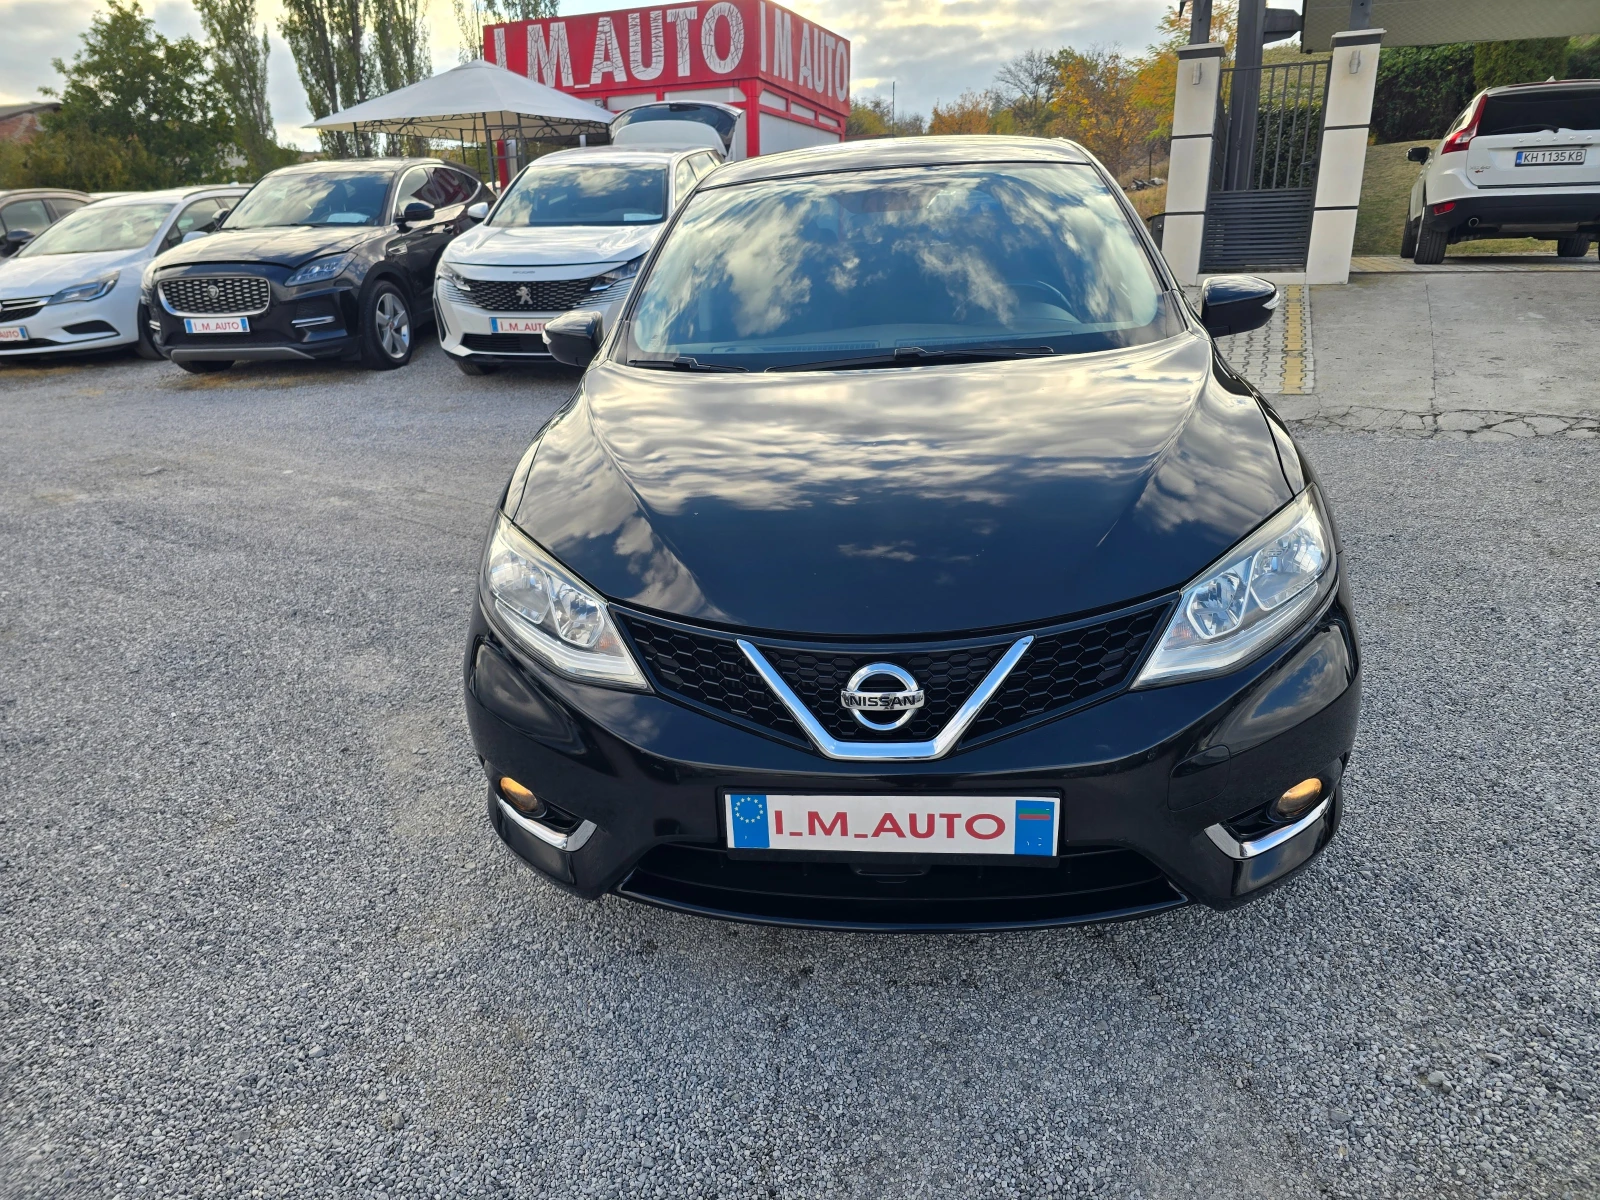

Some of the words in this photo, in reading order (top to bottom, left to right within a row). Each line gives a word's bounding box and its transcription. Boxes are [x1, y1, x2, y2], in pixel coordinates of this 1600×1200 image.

[773, 7, 793, 82] M
[798, 22, 848, 103] AUTO
[1523, 152, 1540, 163] KH
[1541, 151, 1567, 162] 1135
[849, 694, 916, 707] NISSAN
[774, 809, 1006, 840] I_M_AUTO
